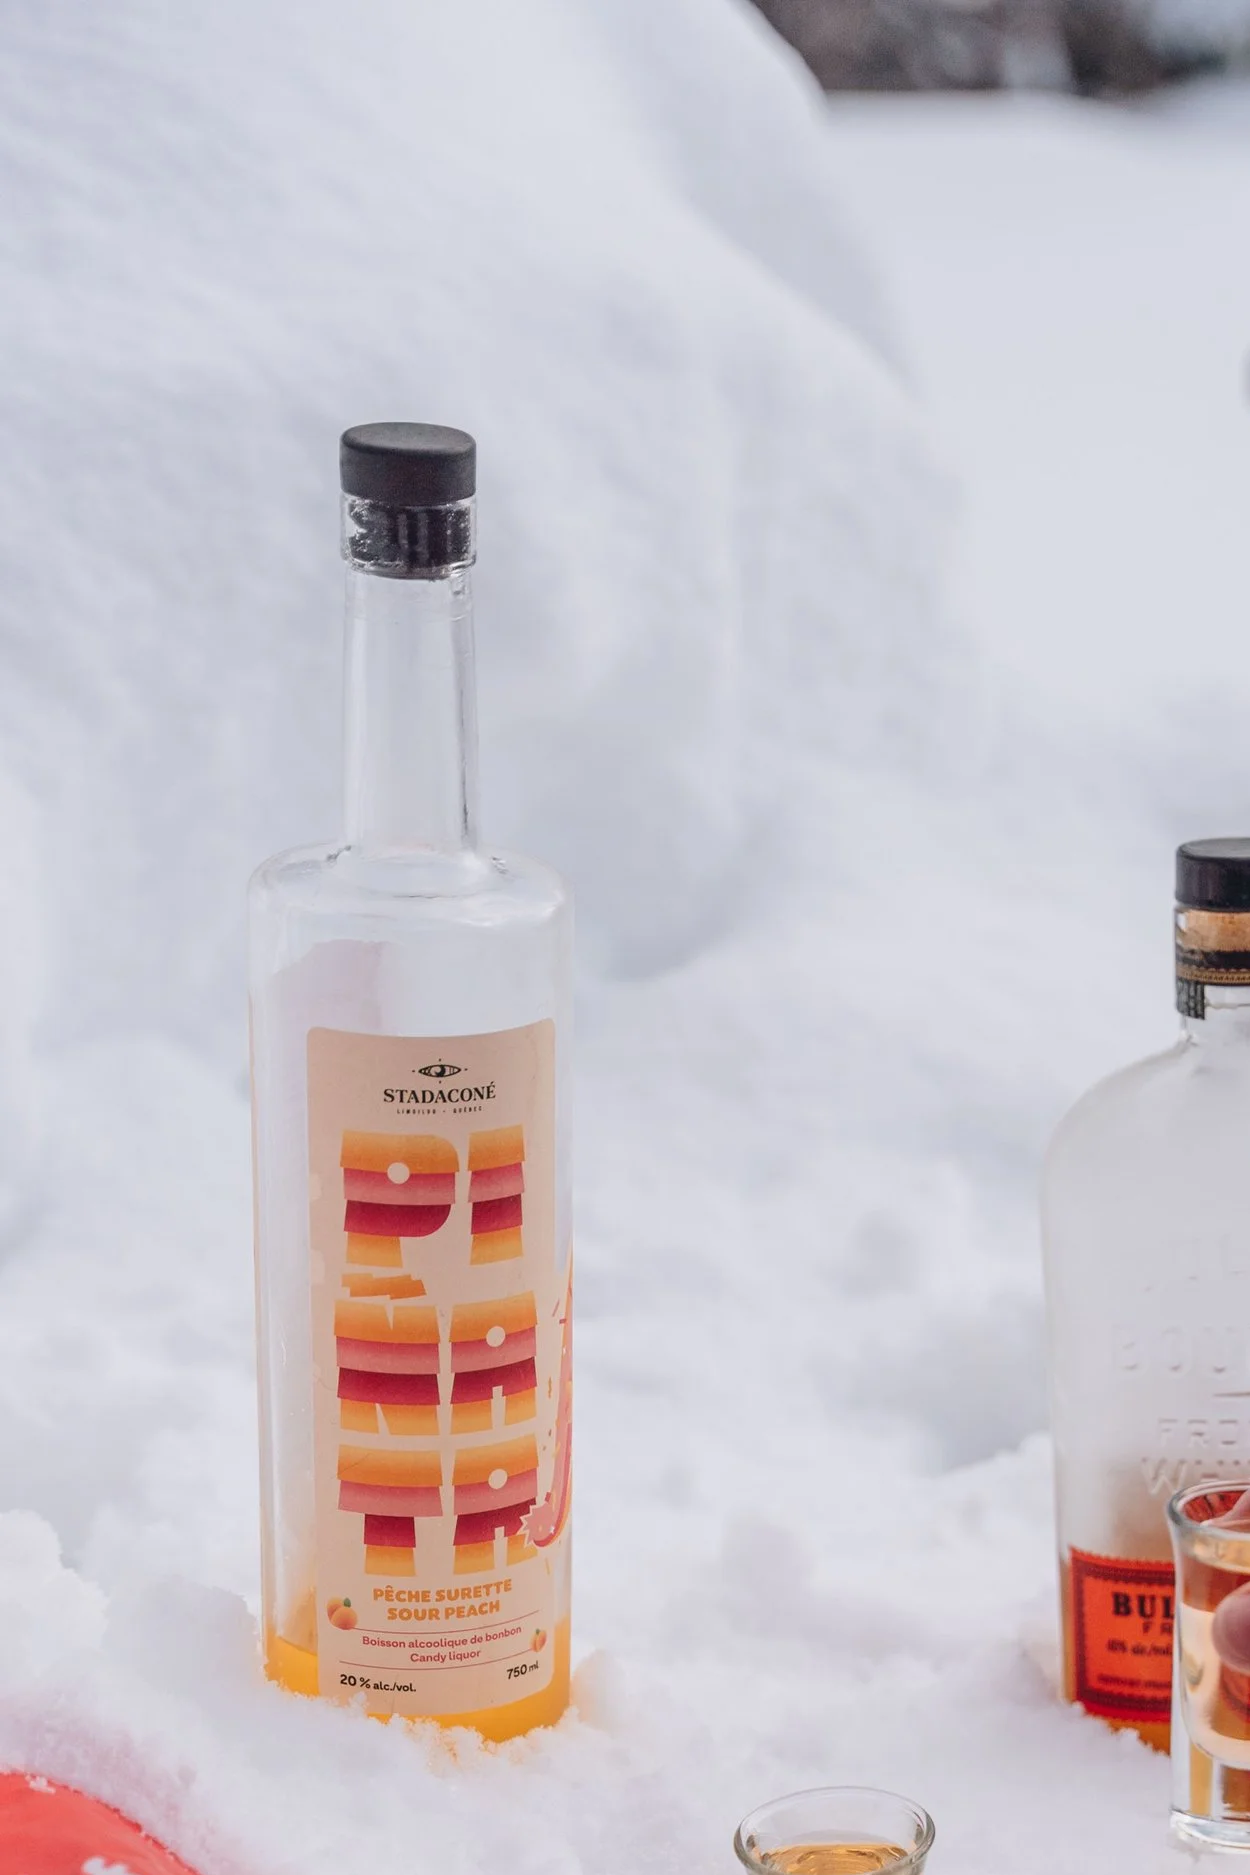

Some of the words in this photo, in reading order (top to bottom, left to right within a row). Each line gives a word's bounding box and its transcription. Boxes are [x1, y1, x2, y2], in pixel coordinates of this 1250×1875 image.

[383, 1081, 496, 1104] STADACONÉ
[372, 1585, 431, 1603] PÊCHE
[434, 1579, 513, 1603] SURETTE
[387, 1607, 440, 1621] SOUR
[445, 1600, 500, 1620] PEACH
[1111, 1592, 1174, 1619] BUL
[362, 1636, 406, 1648] Boisson
[408, 1636, 468, 1652] alcoolique
[470, 1632, 483, 1645] de
[485, 1625, 522, 1642] bonbon
[410, 1651, 447, 1664] Candy
[448, 1650, 481, 1662] liquor
[340, 1674, 357, 1687] 20
[373, 1677, 417, 1692] alc./vol.
[506, 1664, 527, 1680] 750
